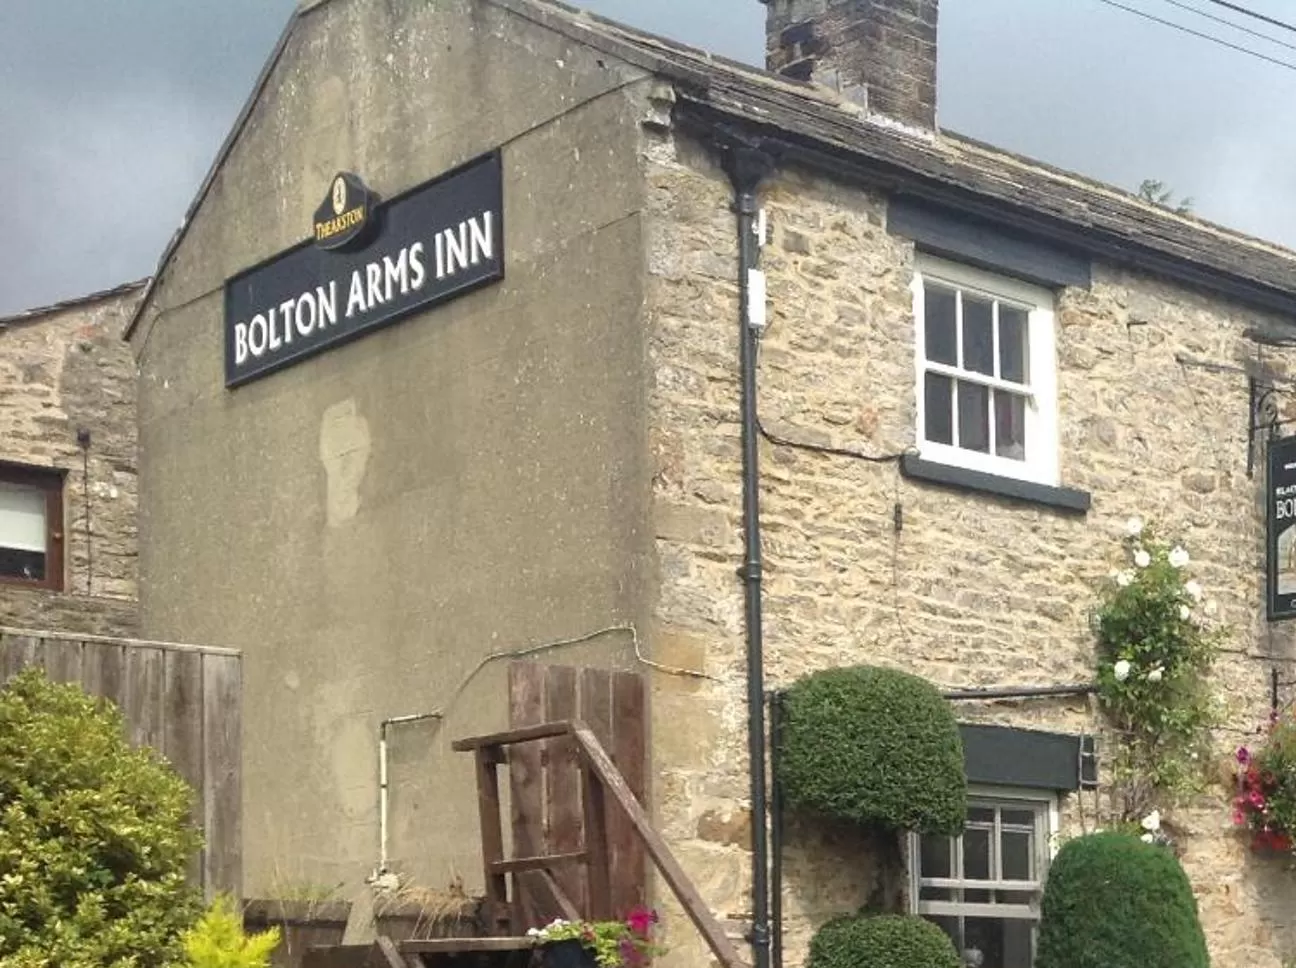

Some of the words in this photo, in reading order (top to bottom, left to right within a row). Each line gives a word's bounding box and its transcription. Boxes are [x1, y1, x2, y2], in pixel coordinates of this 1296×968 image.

[234, 280, 338, 365] BOLTON
[345, 242, 425, 317] ARMS
[434, 210, 493, 279] INN
